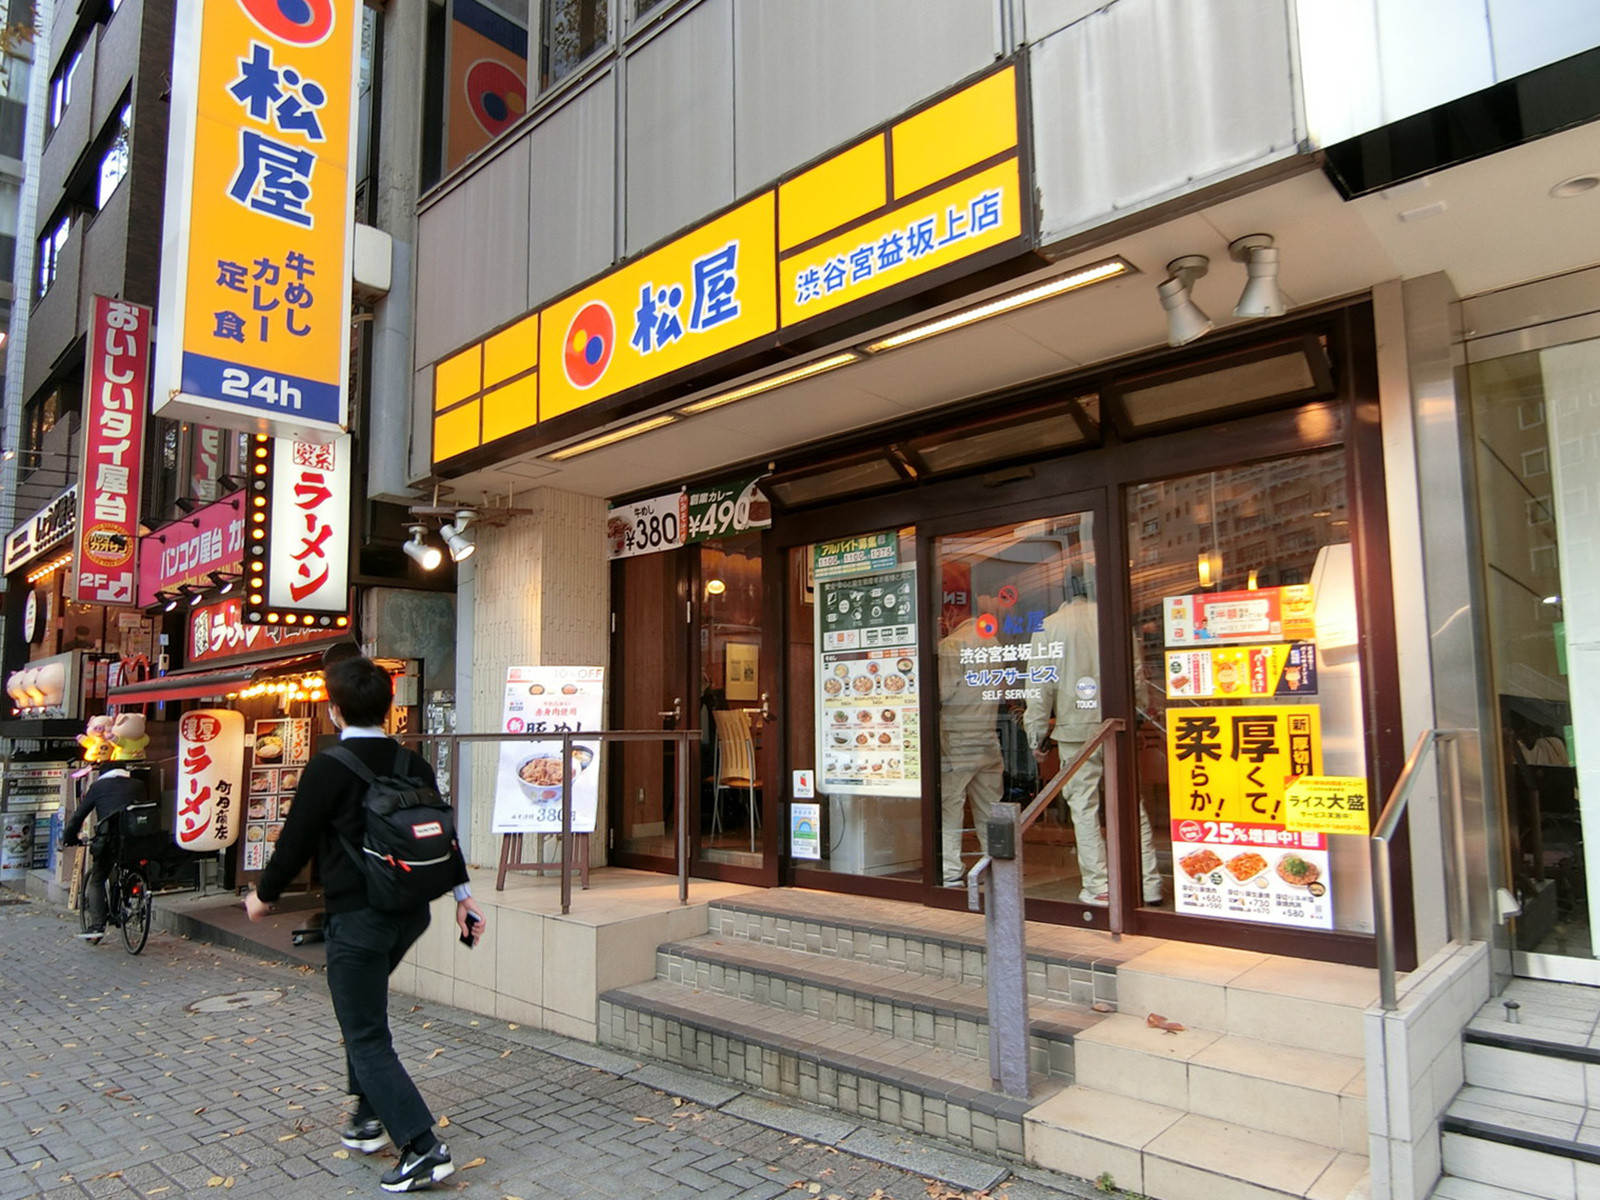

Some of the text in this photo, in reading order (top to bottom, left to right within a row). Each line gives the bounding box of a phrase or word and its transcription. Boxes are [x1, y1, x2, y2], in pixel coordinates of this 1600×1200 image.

[229, 42, 325, 228] 松屋
[795, 190, 1002, 304] 渋谷宮益坂上店
[213, 260, 248, 343] 定食
[253, 258, 280, 341] カレー
[285, 251, 315, 336] 牛めし
[631, 242, 740, 353] 松屋
[94, 301, 138, 523] おいしいタイ屋台
[220, 368, 302, 409] 24h
[290, 471, 333, 602] ラーメン
[625, 512, 677, 551] ¥380
[634, 504, 655, 518] 牛めし
[688, 497, 750, 538] ¥490
[80, 572, 108, 587] 2F
[160, 528, 222, 580] バンコク屋台
[1002, 609, 1046, 635] 松屋
[960, 641, 1064, 664] 渋谷宮益坂上店
[965, 666, 1059, 686] セルフサービス
[982, 688, 1042, 701] SELF SERVICE
[1075, 700, 1098, 709] TOUCH
[178, 745, 212, 843] ラーメン
[1175, 716, 1225, 818] 柔らか!
[1231, 715, 1280, 820] 厚くて!
[214, 779, 232, 840] 町田商店
[1290, 794, 1365, 811] ライス大盛
